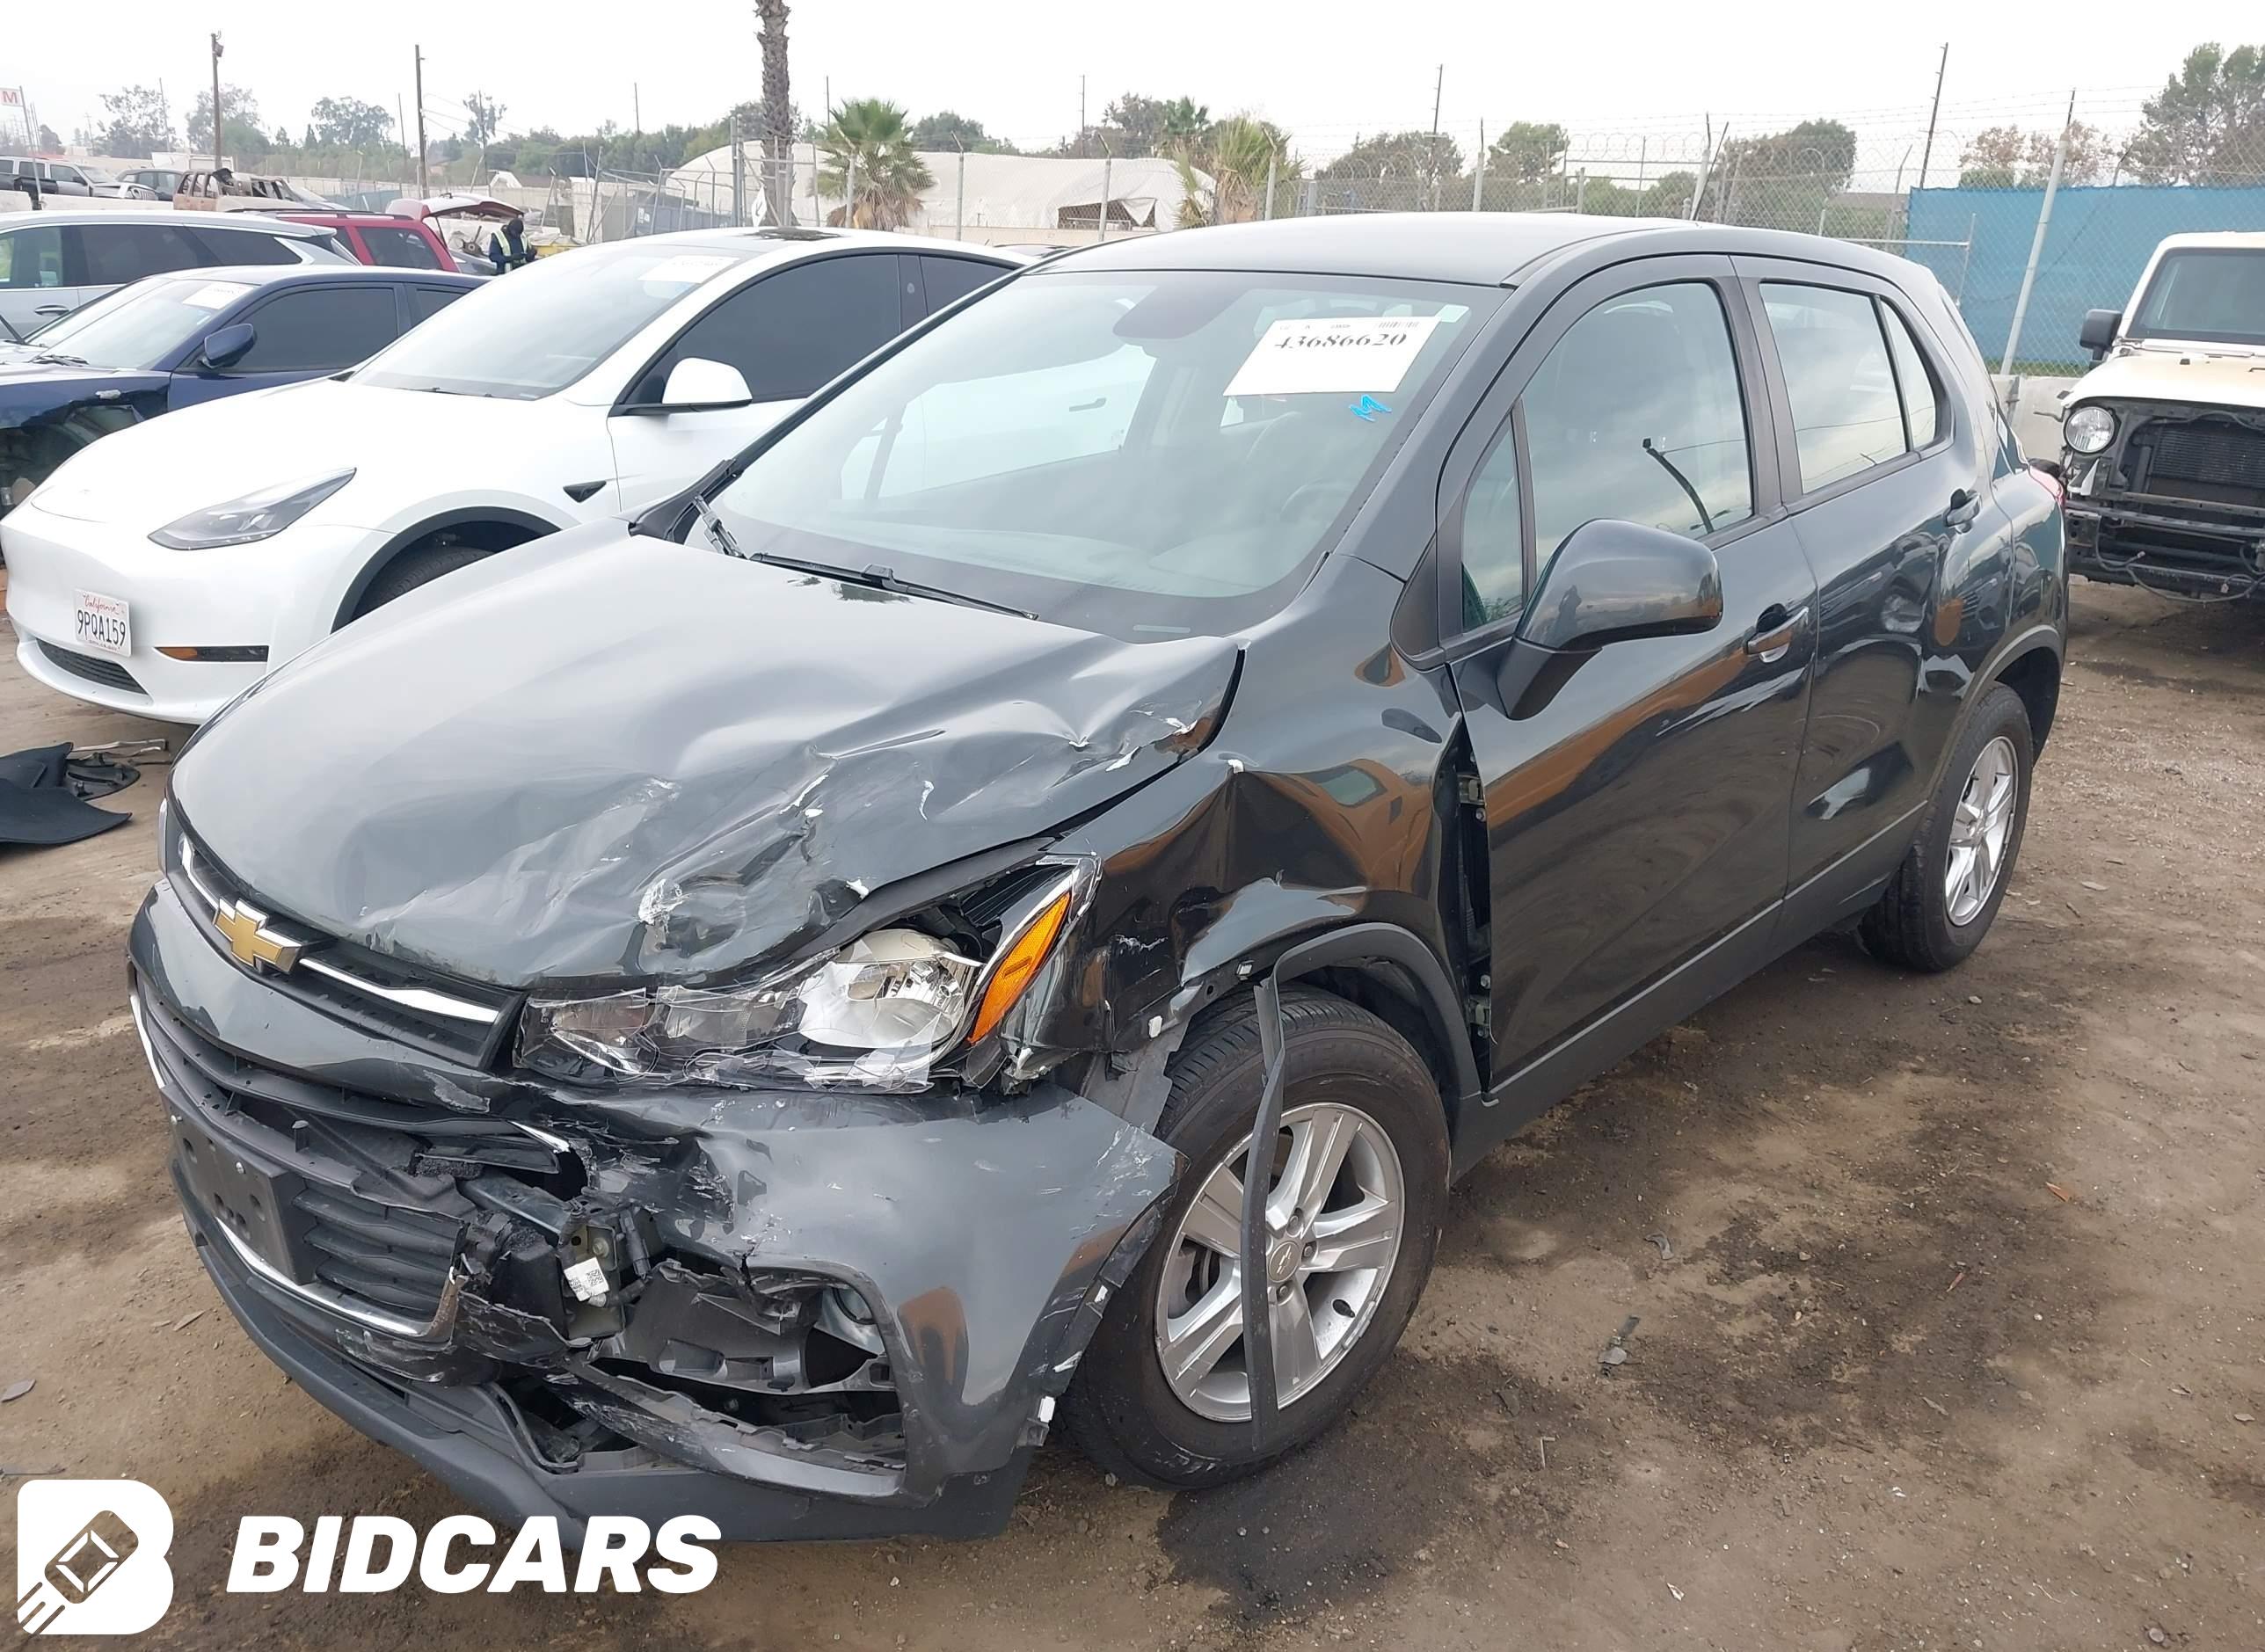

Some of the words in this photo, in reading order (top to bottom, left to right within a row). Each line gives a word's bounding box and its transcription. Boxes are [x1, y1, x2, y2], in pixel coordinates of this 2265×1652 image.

[1275, 332, 1408, 351] 43686620
[84, 594, 120, 615] California
[76, 609, 127, 647] 9PQA159
